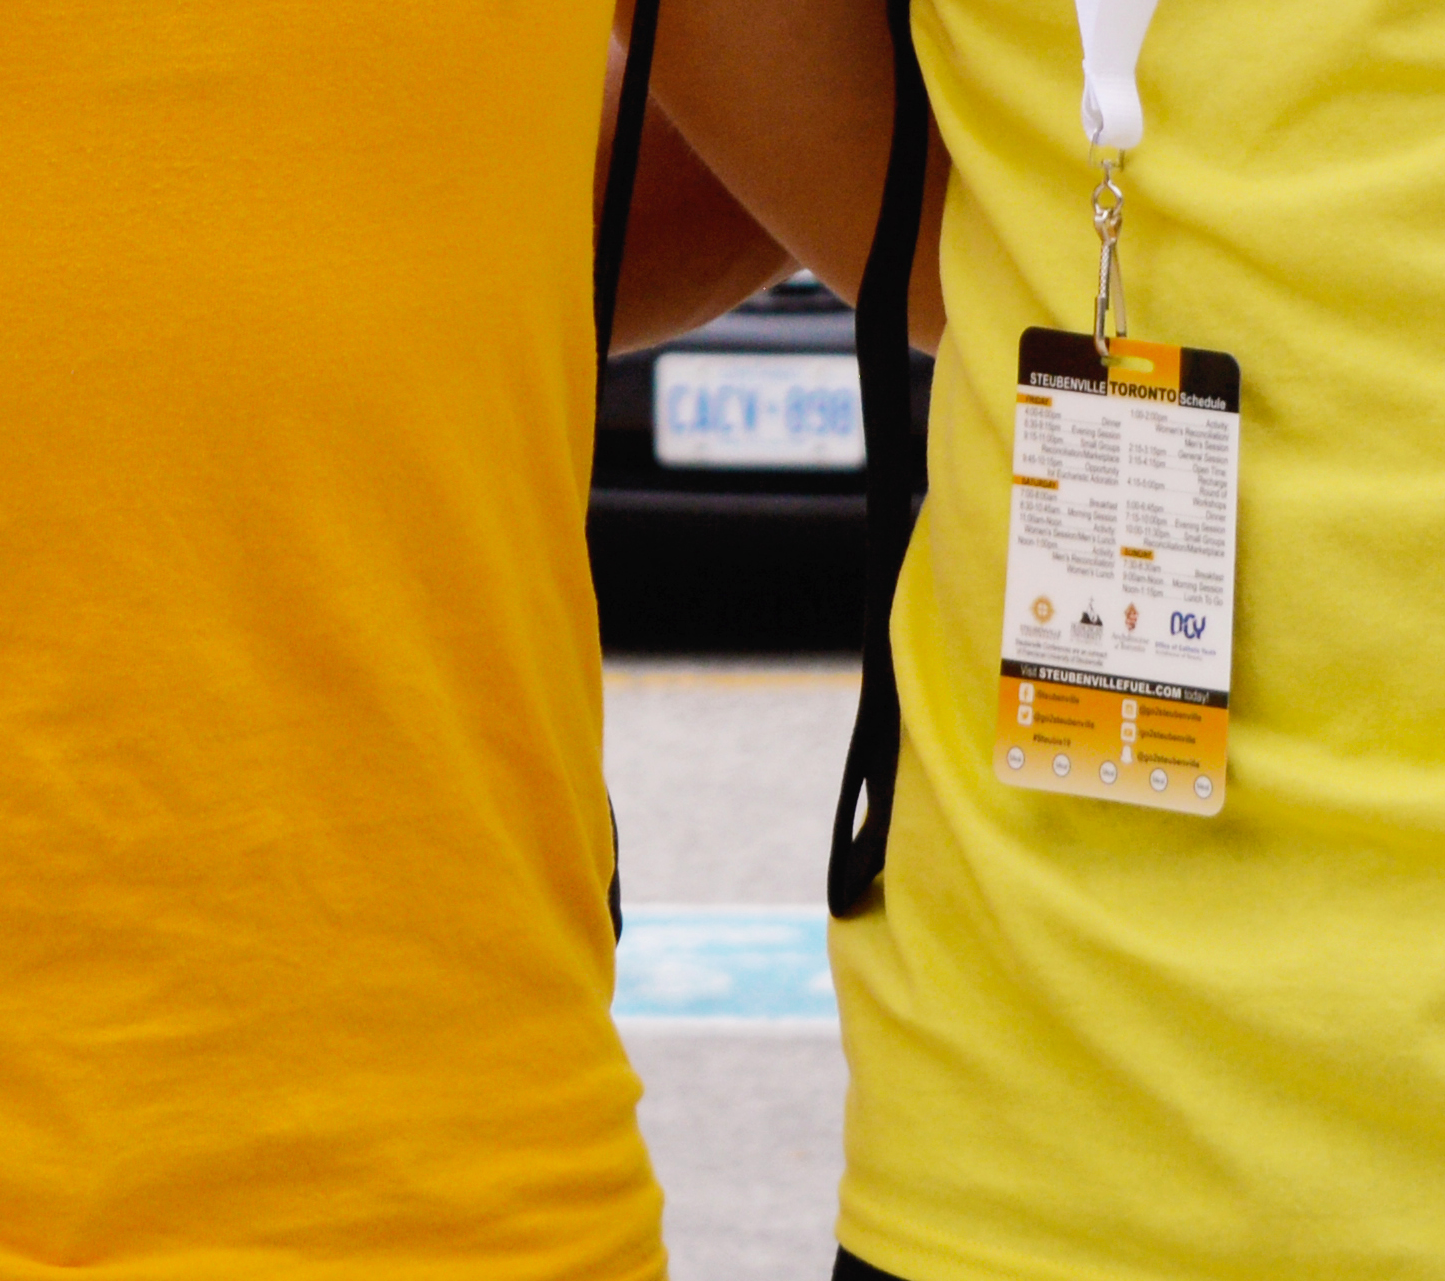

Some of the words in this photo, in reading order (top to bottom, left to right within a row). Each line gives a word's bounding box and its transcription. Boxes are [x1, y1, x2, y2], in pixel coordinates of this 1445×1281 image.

[1030, 371, 1106, 394] STEUBENVILLE
[1109, 381, 1176, 402] TORONTO
[1179, 391, 1226, 410] Schedule
[1101, 416, 1121, 427] Dinner
[1071, 424, 1096, 438] Evening
[1204, 440, 1228, 452] Session
[1203, 453, 1228, 464] Session
[1192, 463, 1209, 475] Open
[1067, 506, 1091, 520] Morning
[1205, 510, 1225, 522] Dinner
[1174, 518, 1199, 532] Evening
[1201, 521, 1225, 533] Session
[1172, 578, 1197, 593] Morning
[1198, 581, 1223, 594] Session
[1183, 592, 1203, 603] Lunch
[1038, 666, 1181, 699] STEUBENVILLEFUEL.COM
[1184, 688, 1209, 706] today!
